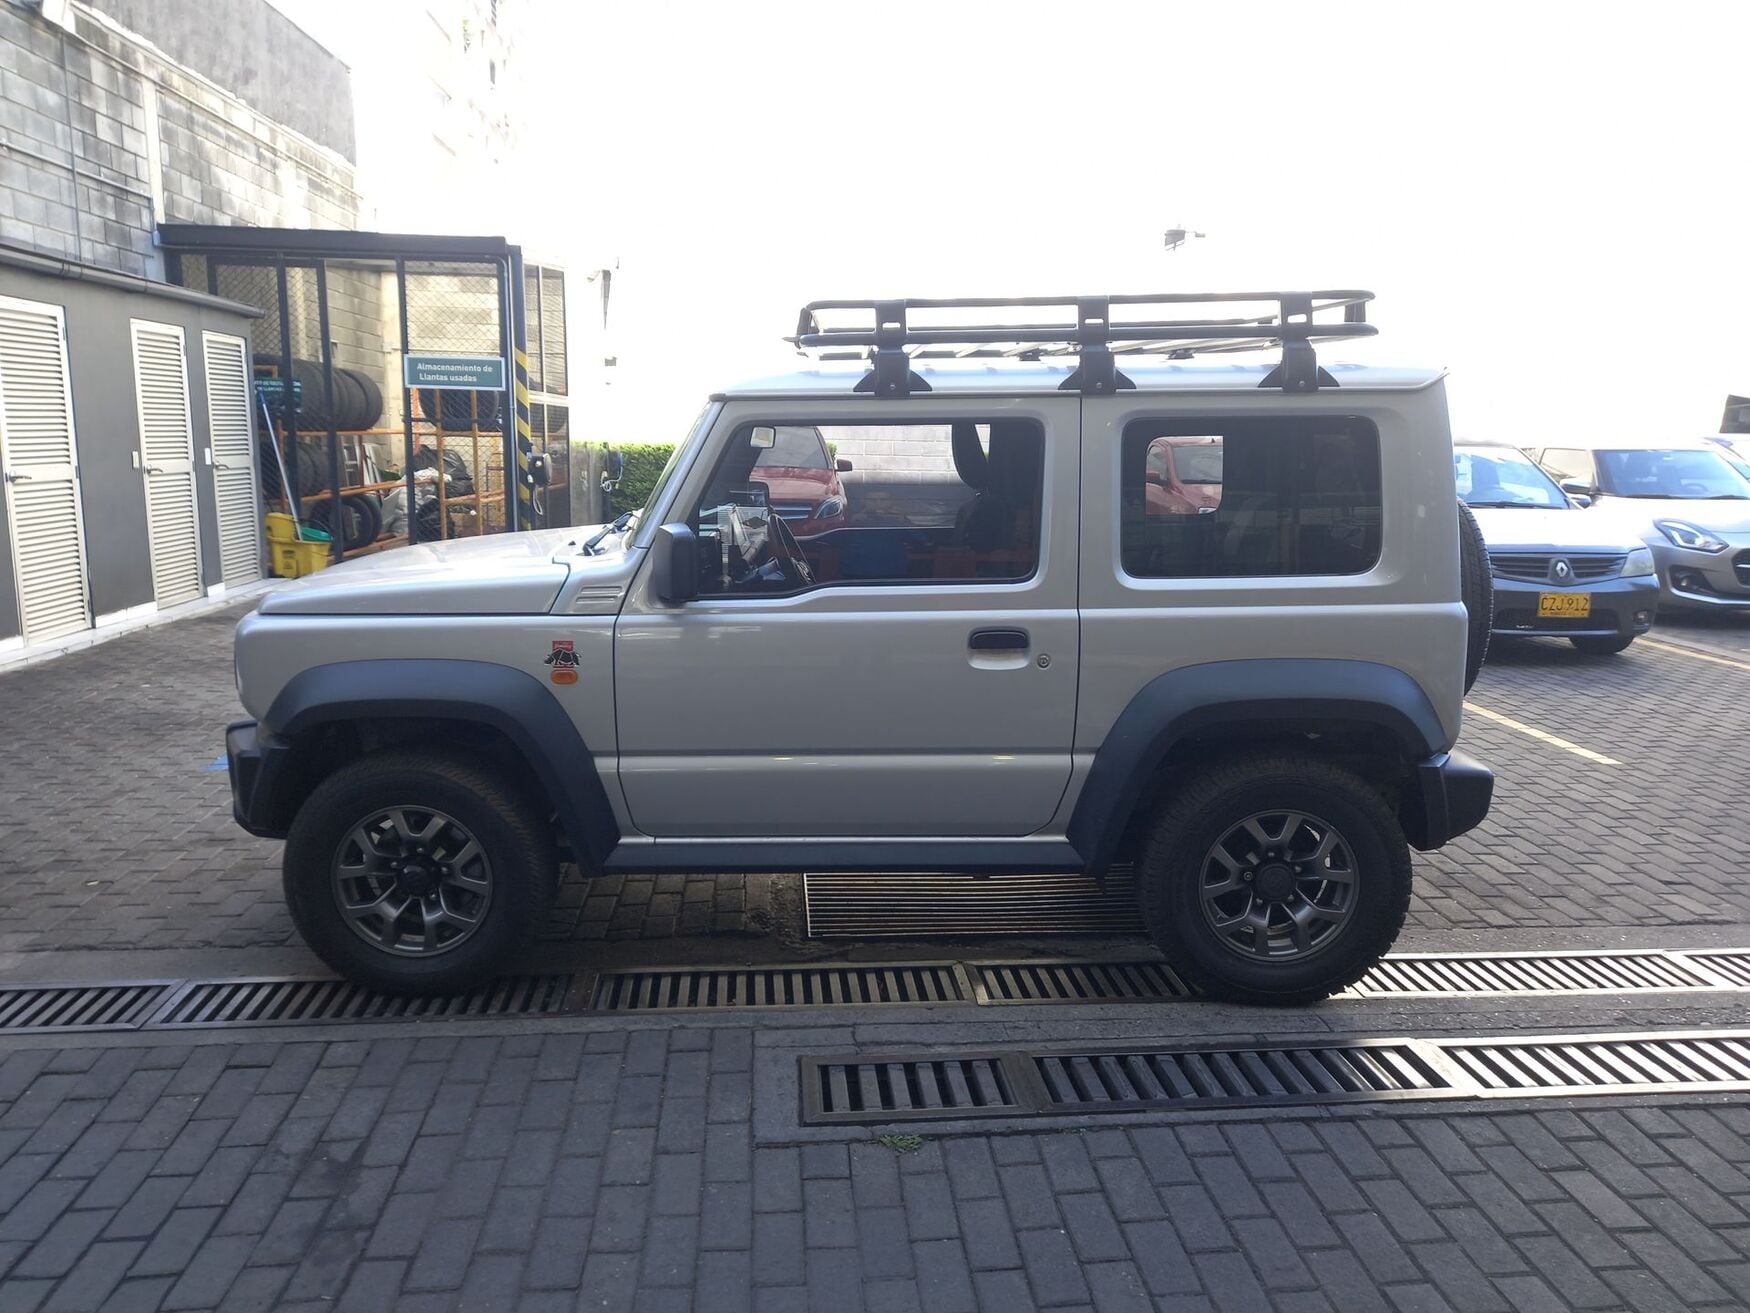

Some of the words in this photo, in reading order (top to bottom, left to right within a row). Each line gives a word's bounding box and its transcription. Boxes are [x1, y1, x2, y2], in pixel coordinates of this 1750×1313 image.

[417, 363, 482, 372] Almacenamiento
[419, 373, 448, 381] Llantas
[449, 374, 477, 382] usadas
